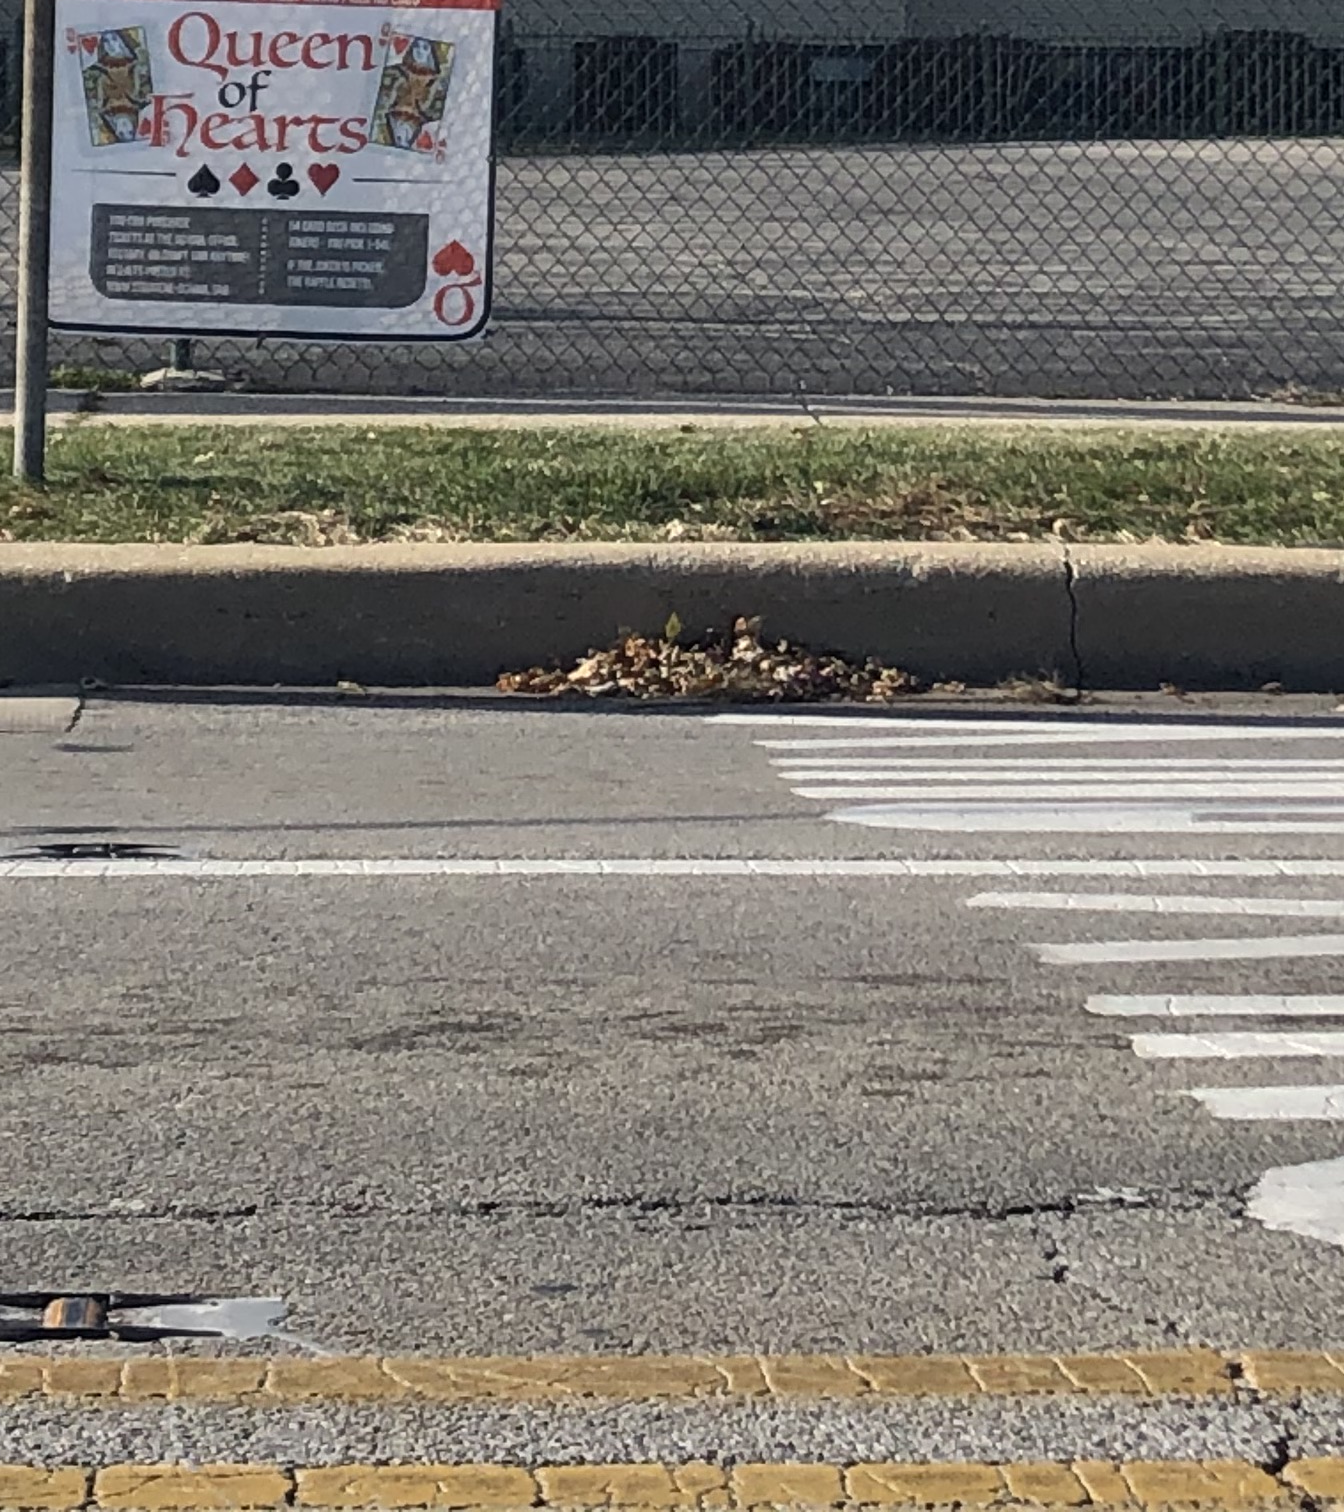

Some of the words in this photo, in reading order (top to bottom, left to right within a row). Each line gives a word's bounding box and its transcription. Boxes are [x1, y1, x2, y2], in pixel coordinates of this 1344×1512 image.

[167, 11, 378, 83] Queen
[218, 69, 272, 112] of
[433, 269, 482, 326] Q
